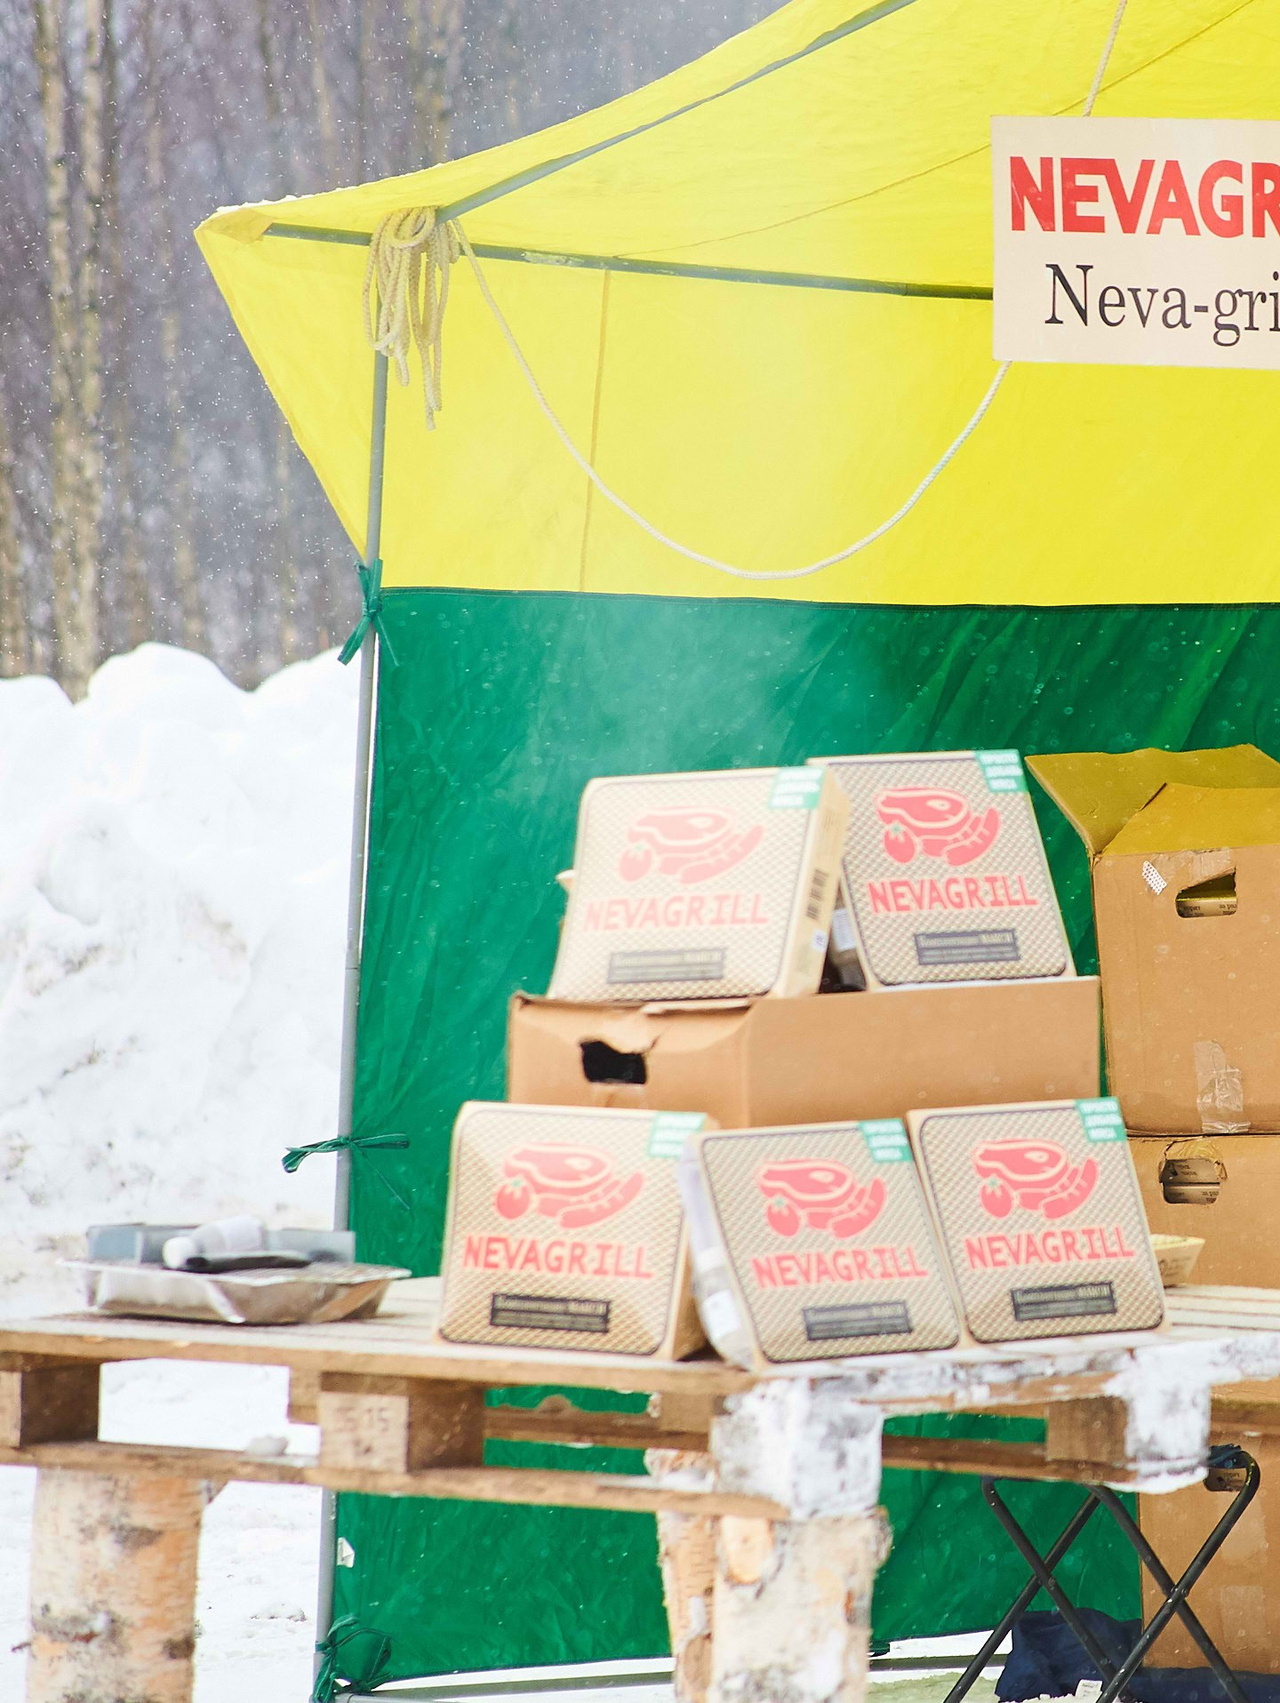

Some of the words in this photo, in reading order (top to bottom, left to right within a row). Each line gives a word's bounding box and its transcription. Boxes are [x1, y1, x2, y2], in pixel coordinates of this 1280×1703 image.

[583, 892, 769, 931] NEVAGRILL
[866, 874, 1039, 914] NEVAGRILL
[461, 1233, 655, 1280] NEVAGRILL
[750, 1245, 929, 1288] NEVAGRILL
[962, 1226, 1136, 1270] NEVAGRILL
